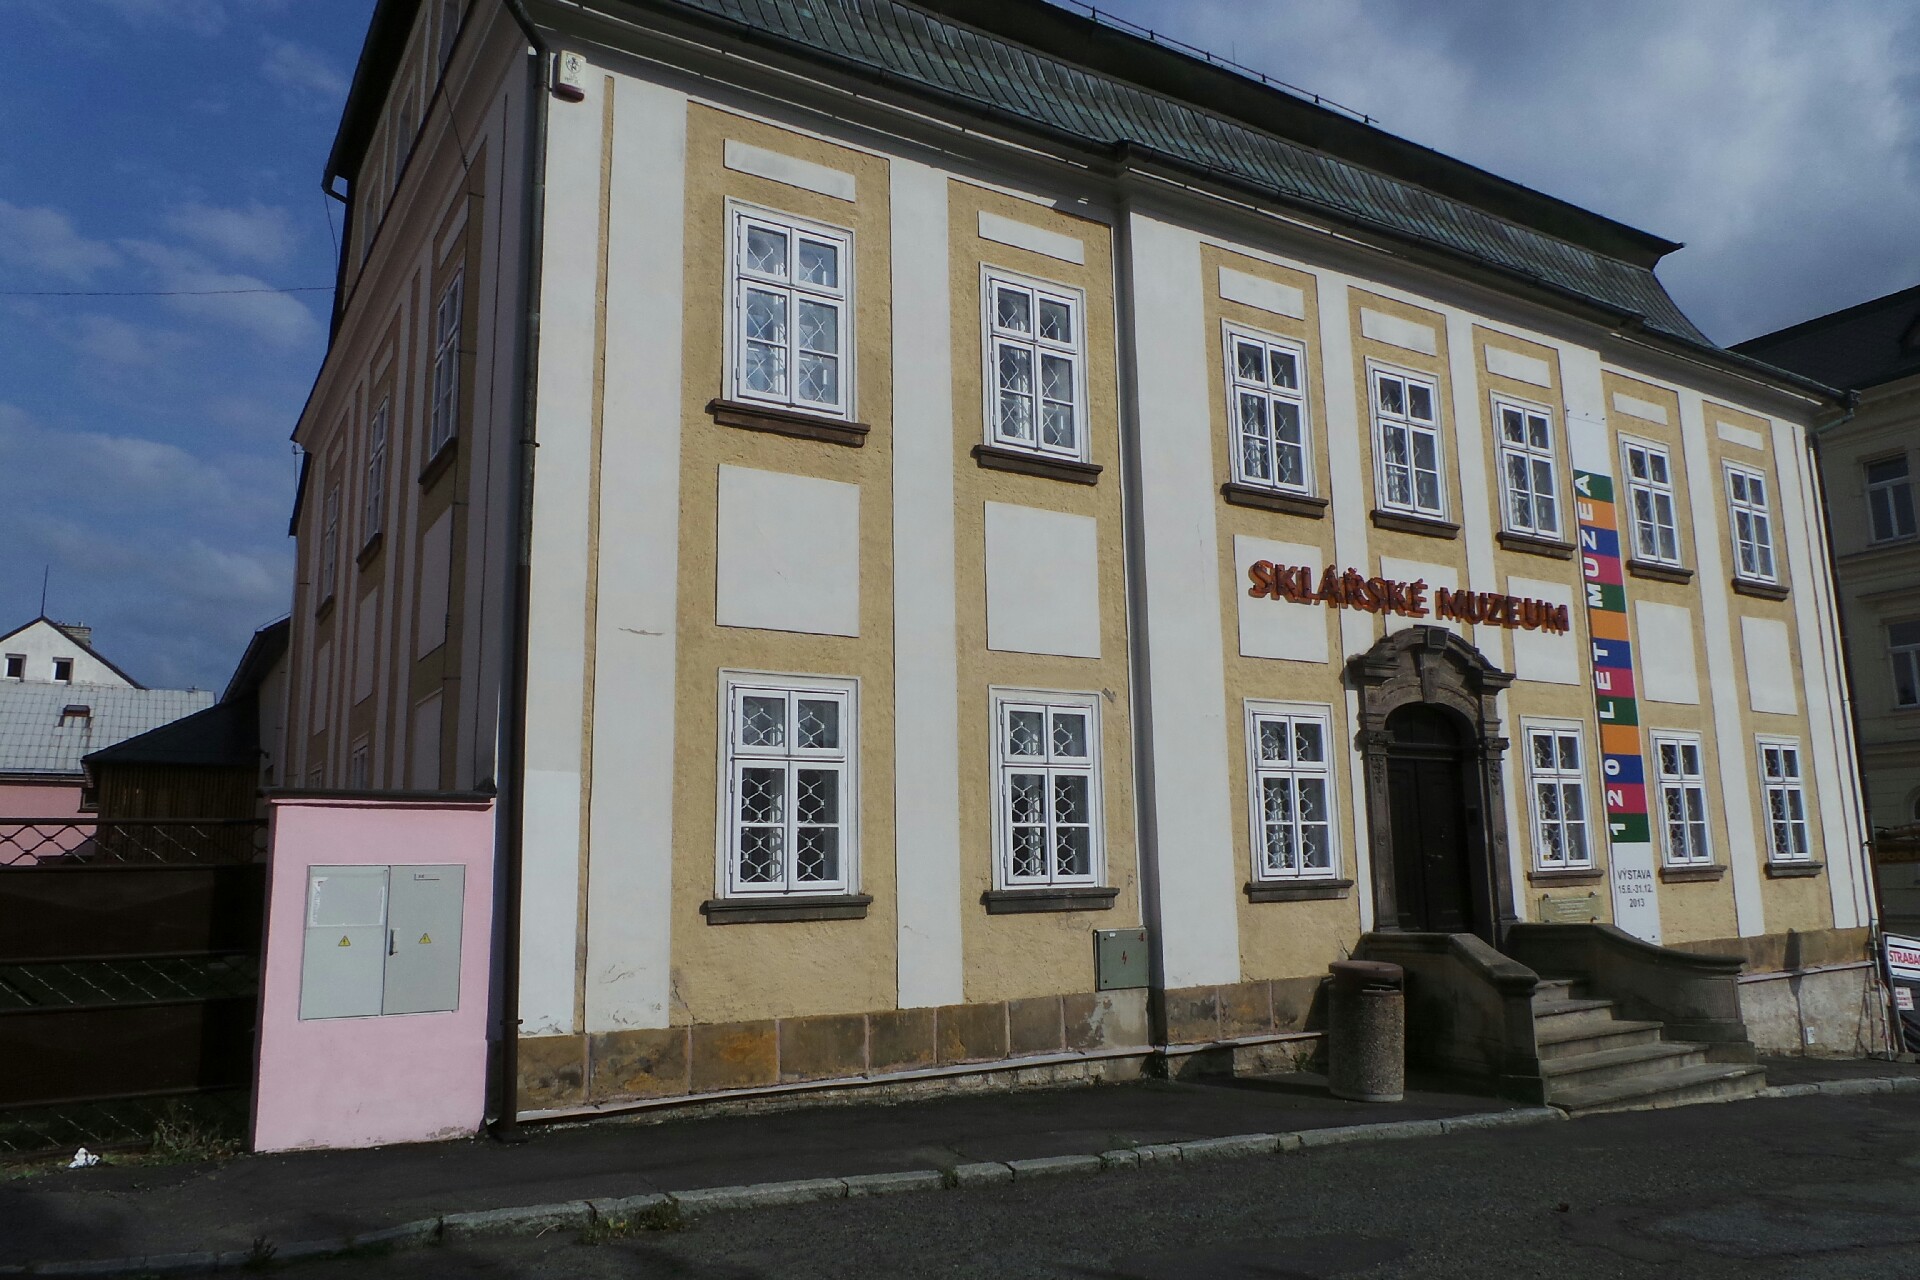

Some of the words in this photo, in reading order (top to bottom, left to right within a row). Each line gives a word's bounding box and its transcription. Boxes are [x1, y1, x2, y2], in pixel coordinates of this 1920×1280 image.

[1575, 474, 1603, 608] MUZEA
[1248, 559, 1430, 618] SKLÁŘSKÉ
[1435, 587, 1570, 636] MUZEUM
[1593, 642, 1615, 719] LET
[1604, 758, 1626, 836] 120
[1617, 868, 1652, 880] VÝSTAVA
[1629, 898, 1645, 908] 2013
[1889, 950, 1920, 965] STRABA
